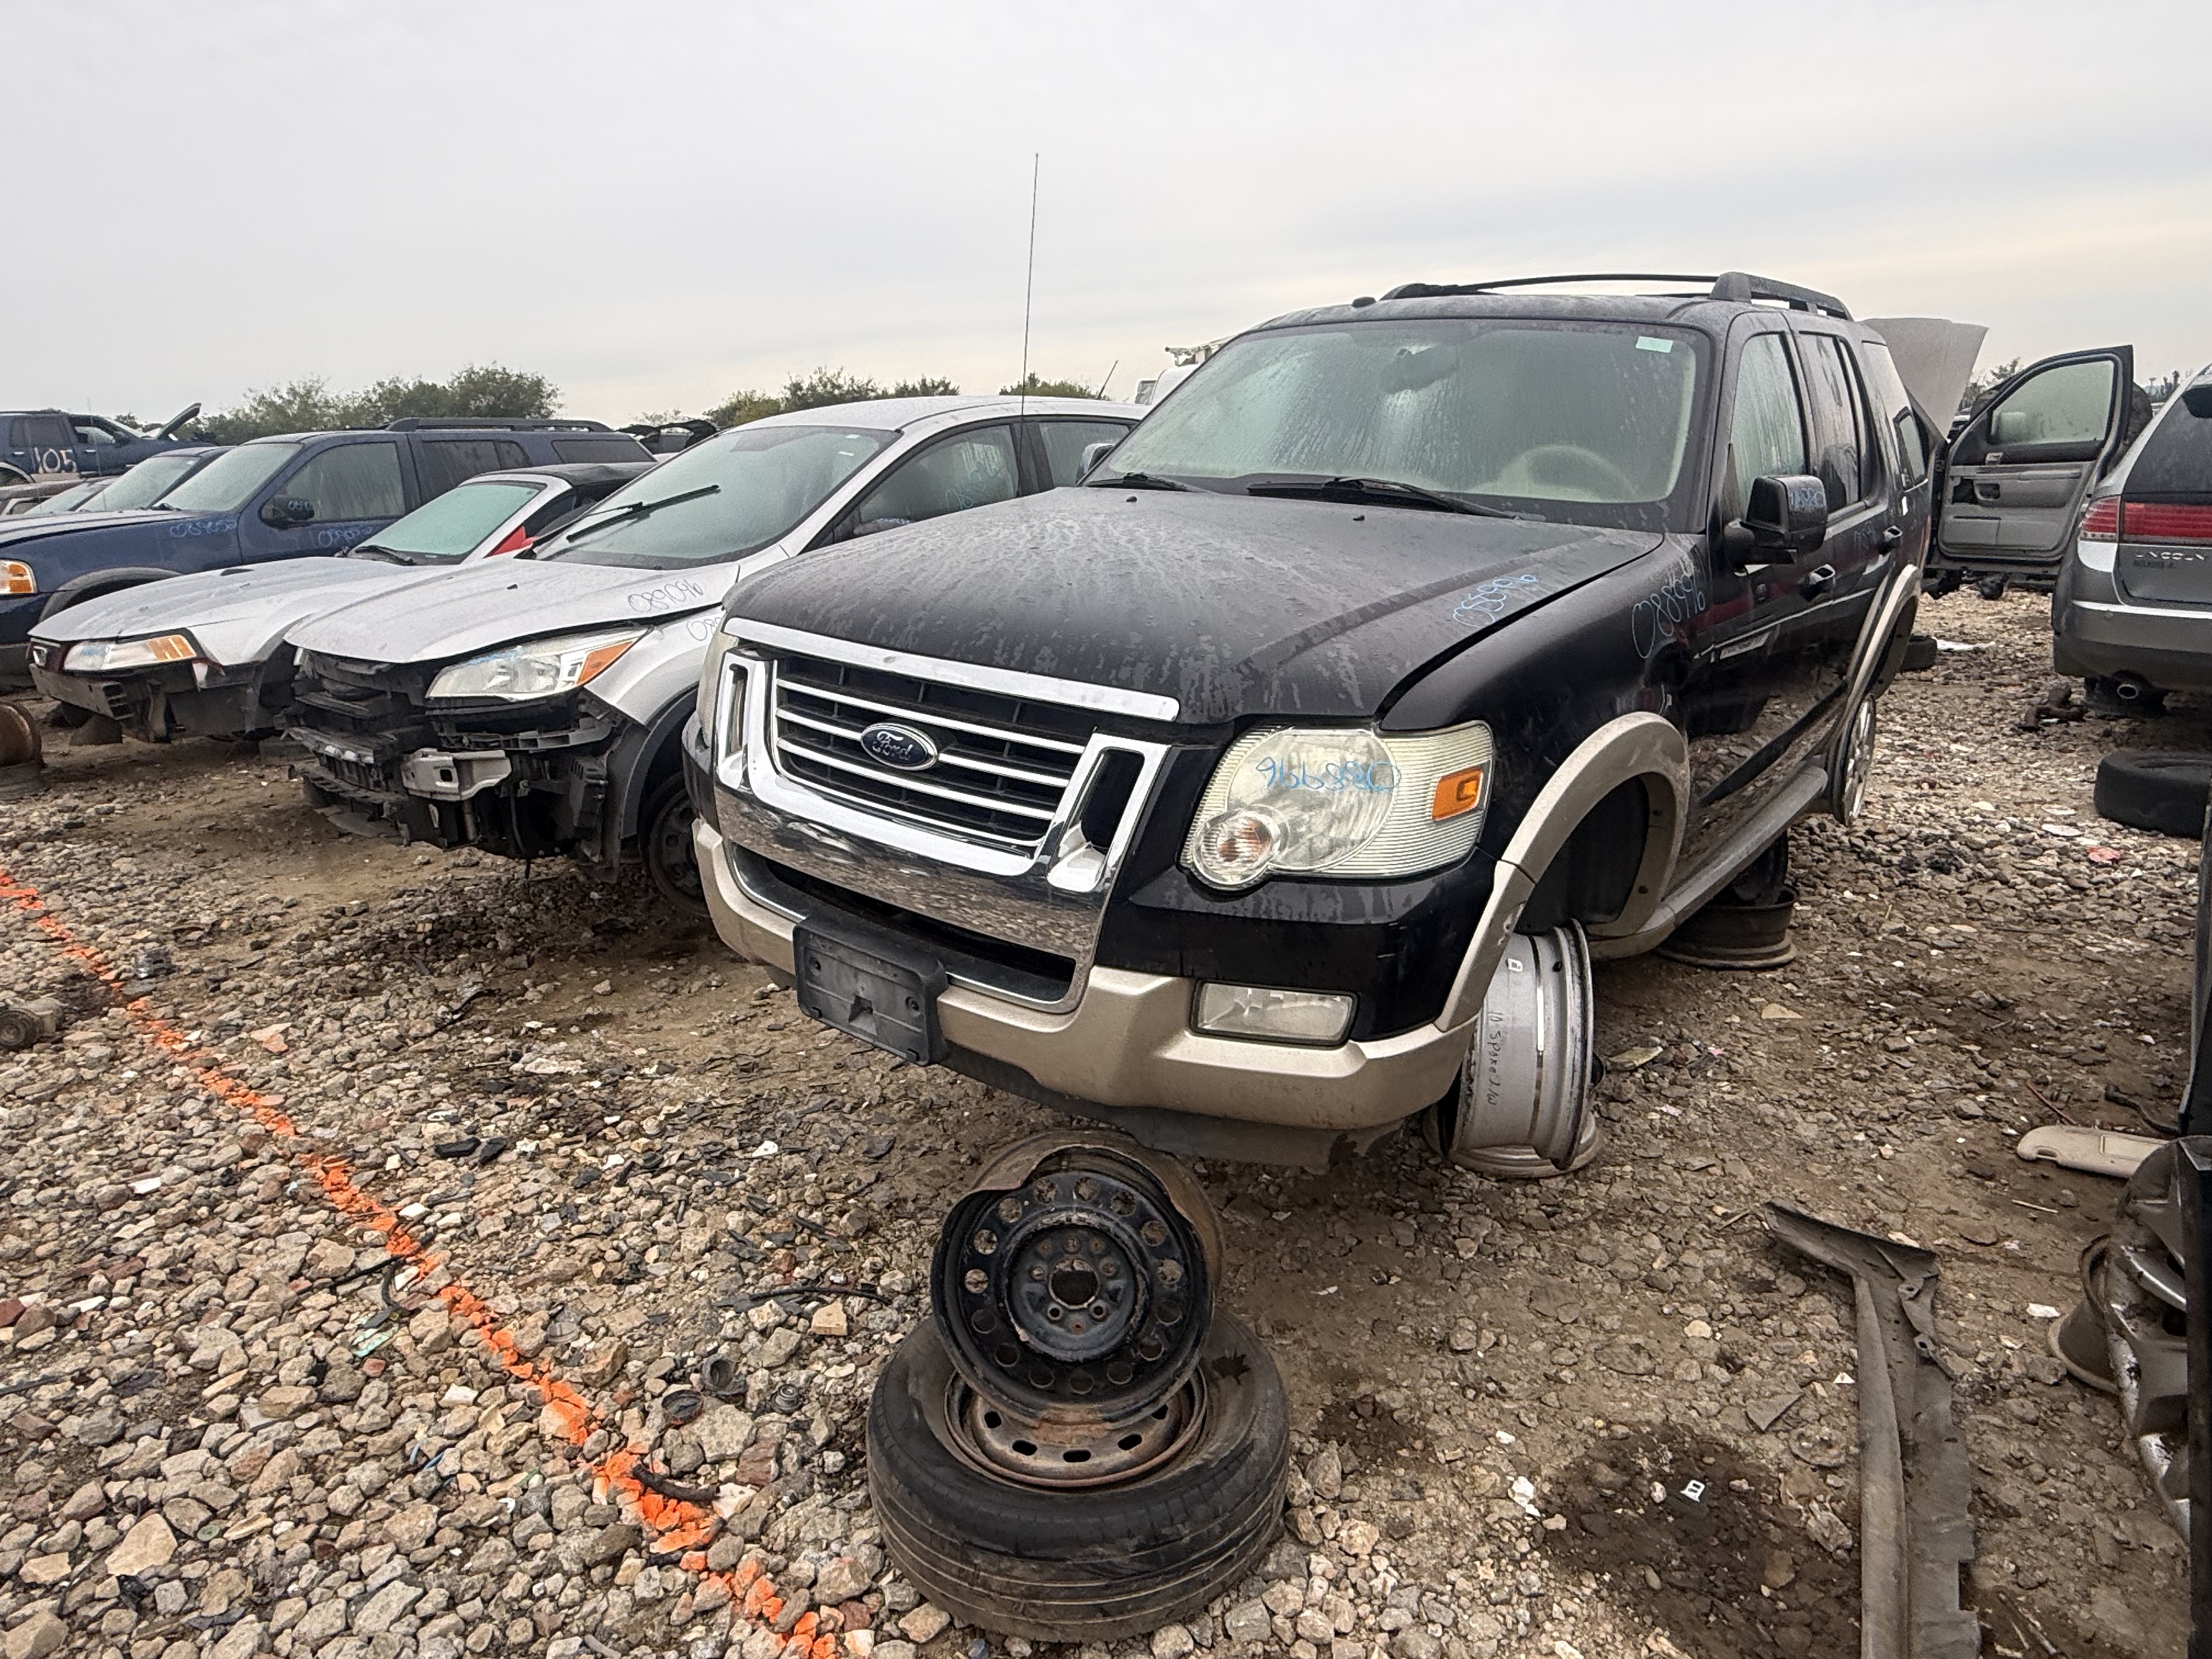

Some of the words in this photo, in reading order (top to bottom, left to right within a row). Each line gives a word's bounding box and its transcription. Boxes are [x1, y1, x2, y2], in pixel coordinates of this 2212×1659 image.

[34, 447, 77, 473] 105
[2135, 550, 2208, 561] LNCOLN
[628, 579, 704, 613] 089096
[1632, 573, 1705, 659] 088996
[872, 731, 914, 761] Ford
